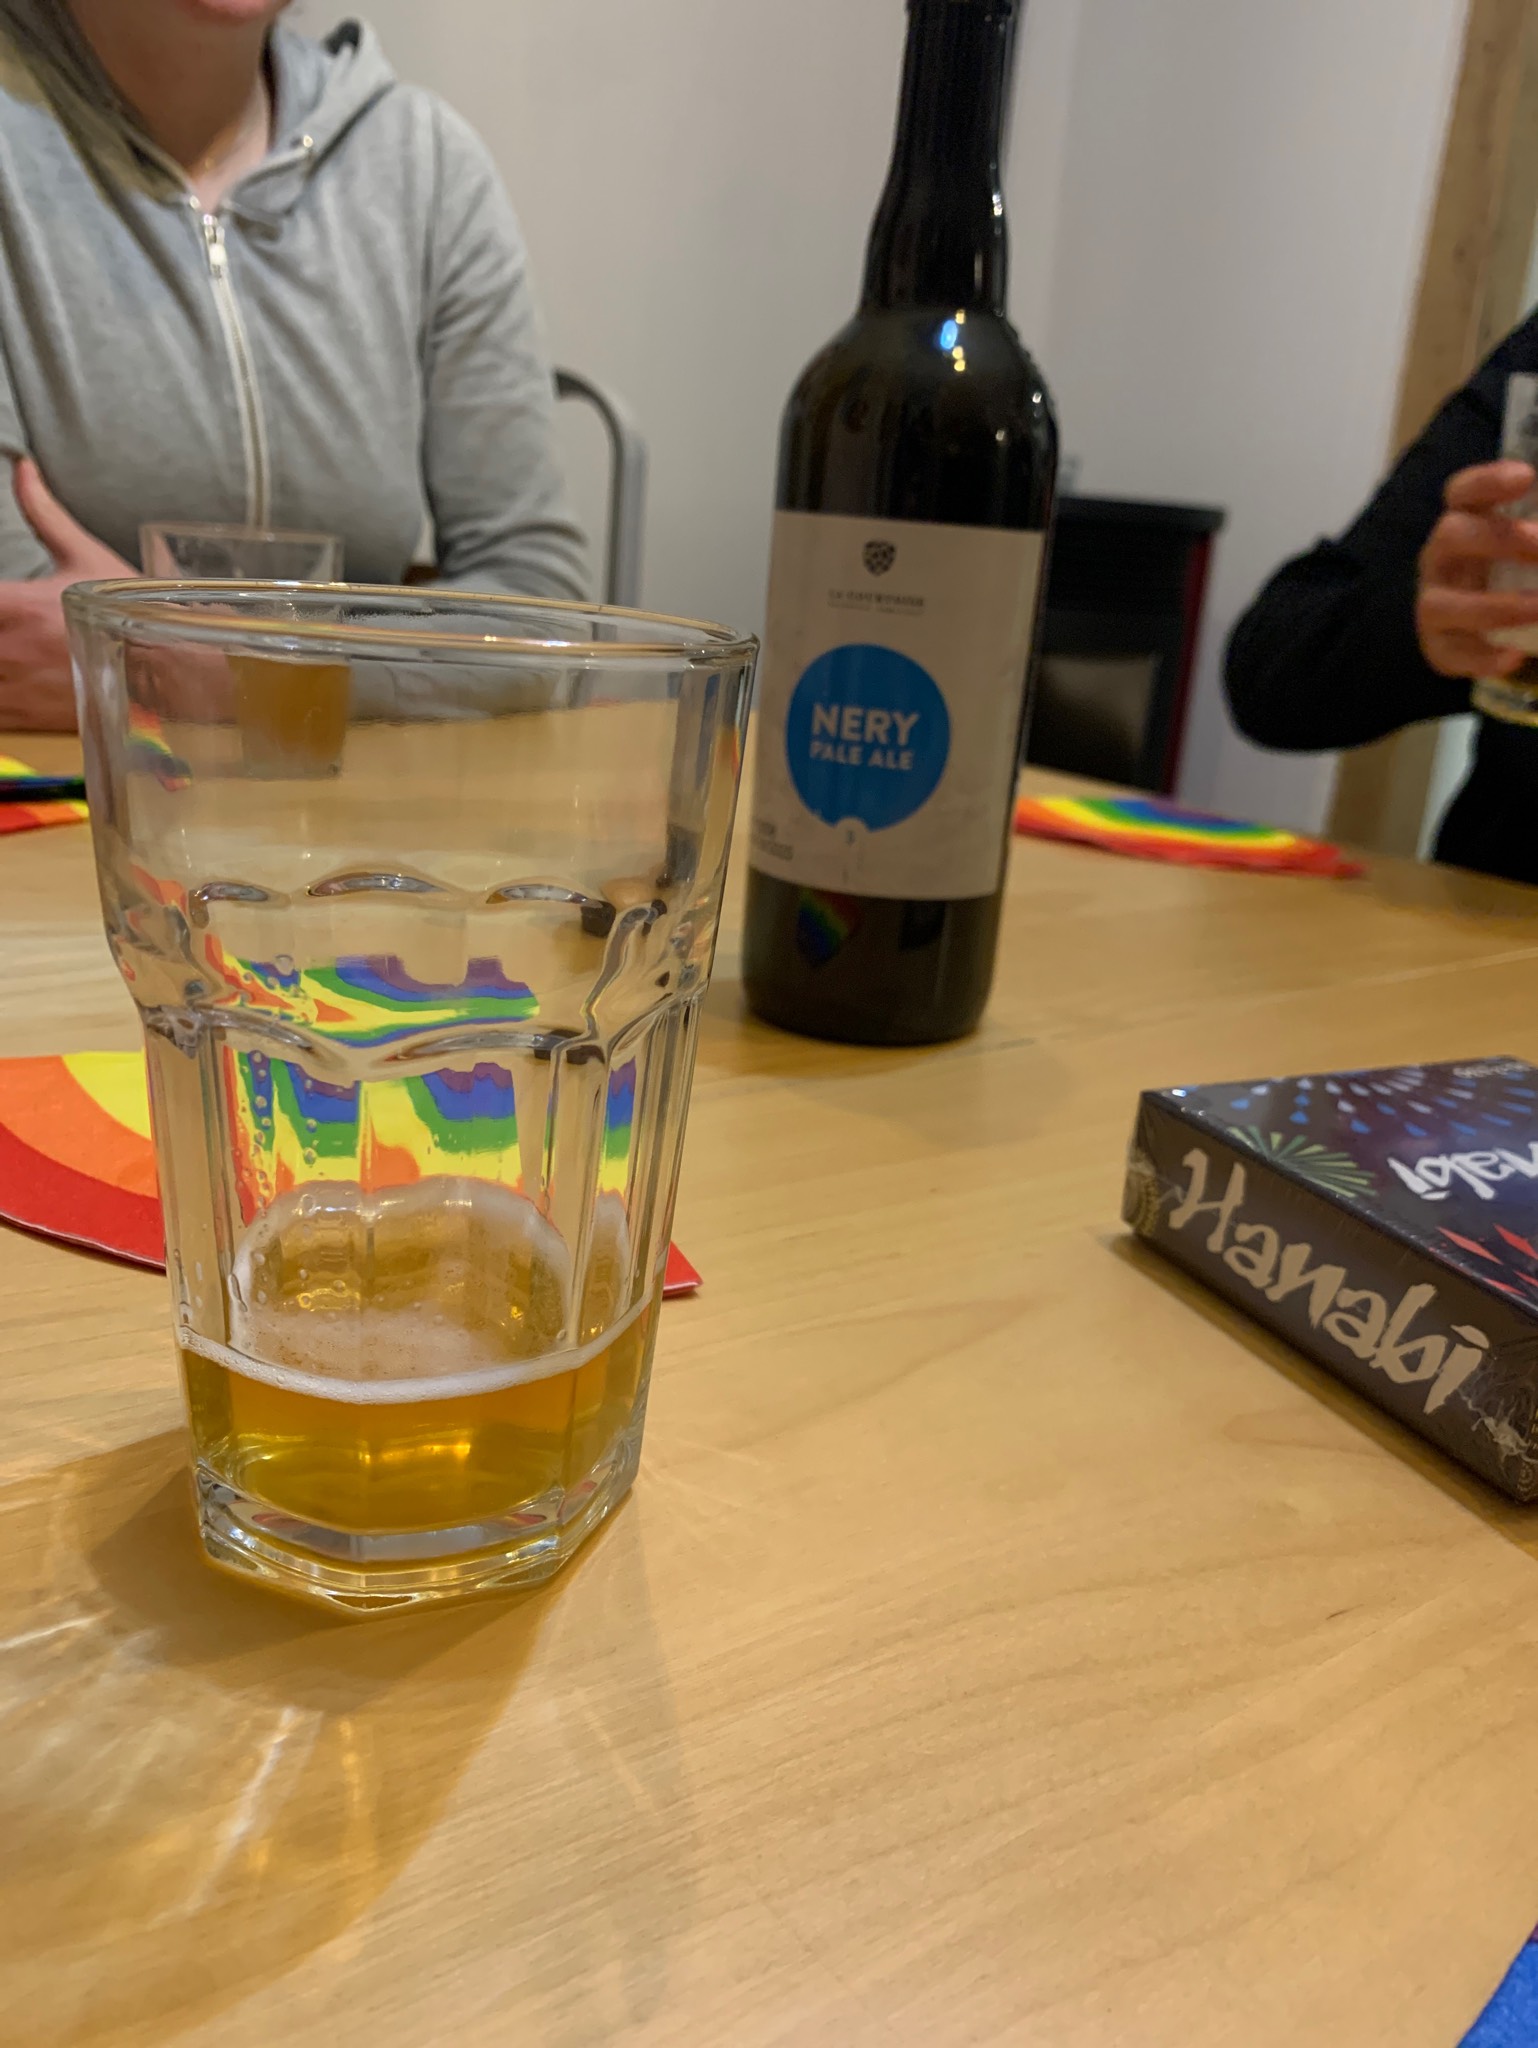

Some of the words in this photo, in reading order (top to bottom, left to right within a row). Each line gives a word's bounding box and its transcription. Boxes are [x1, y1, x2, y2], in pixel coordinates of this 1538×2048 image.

[811, 702, 919, 746] NERY
[809, 741, 863, 766] PALE
[867, 748, 915, 770] ALE
[1168, 1148, 1489, 1414] Hanabi
